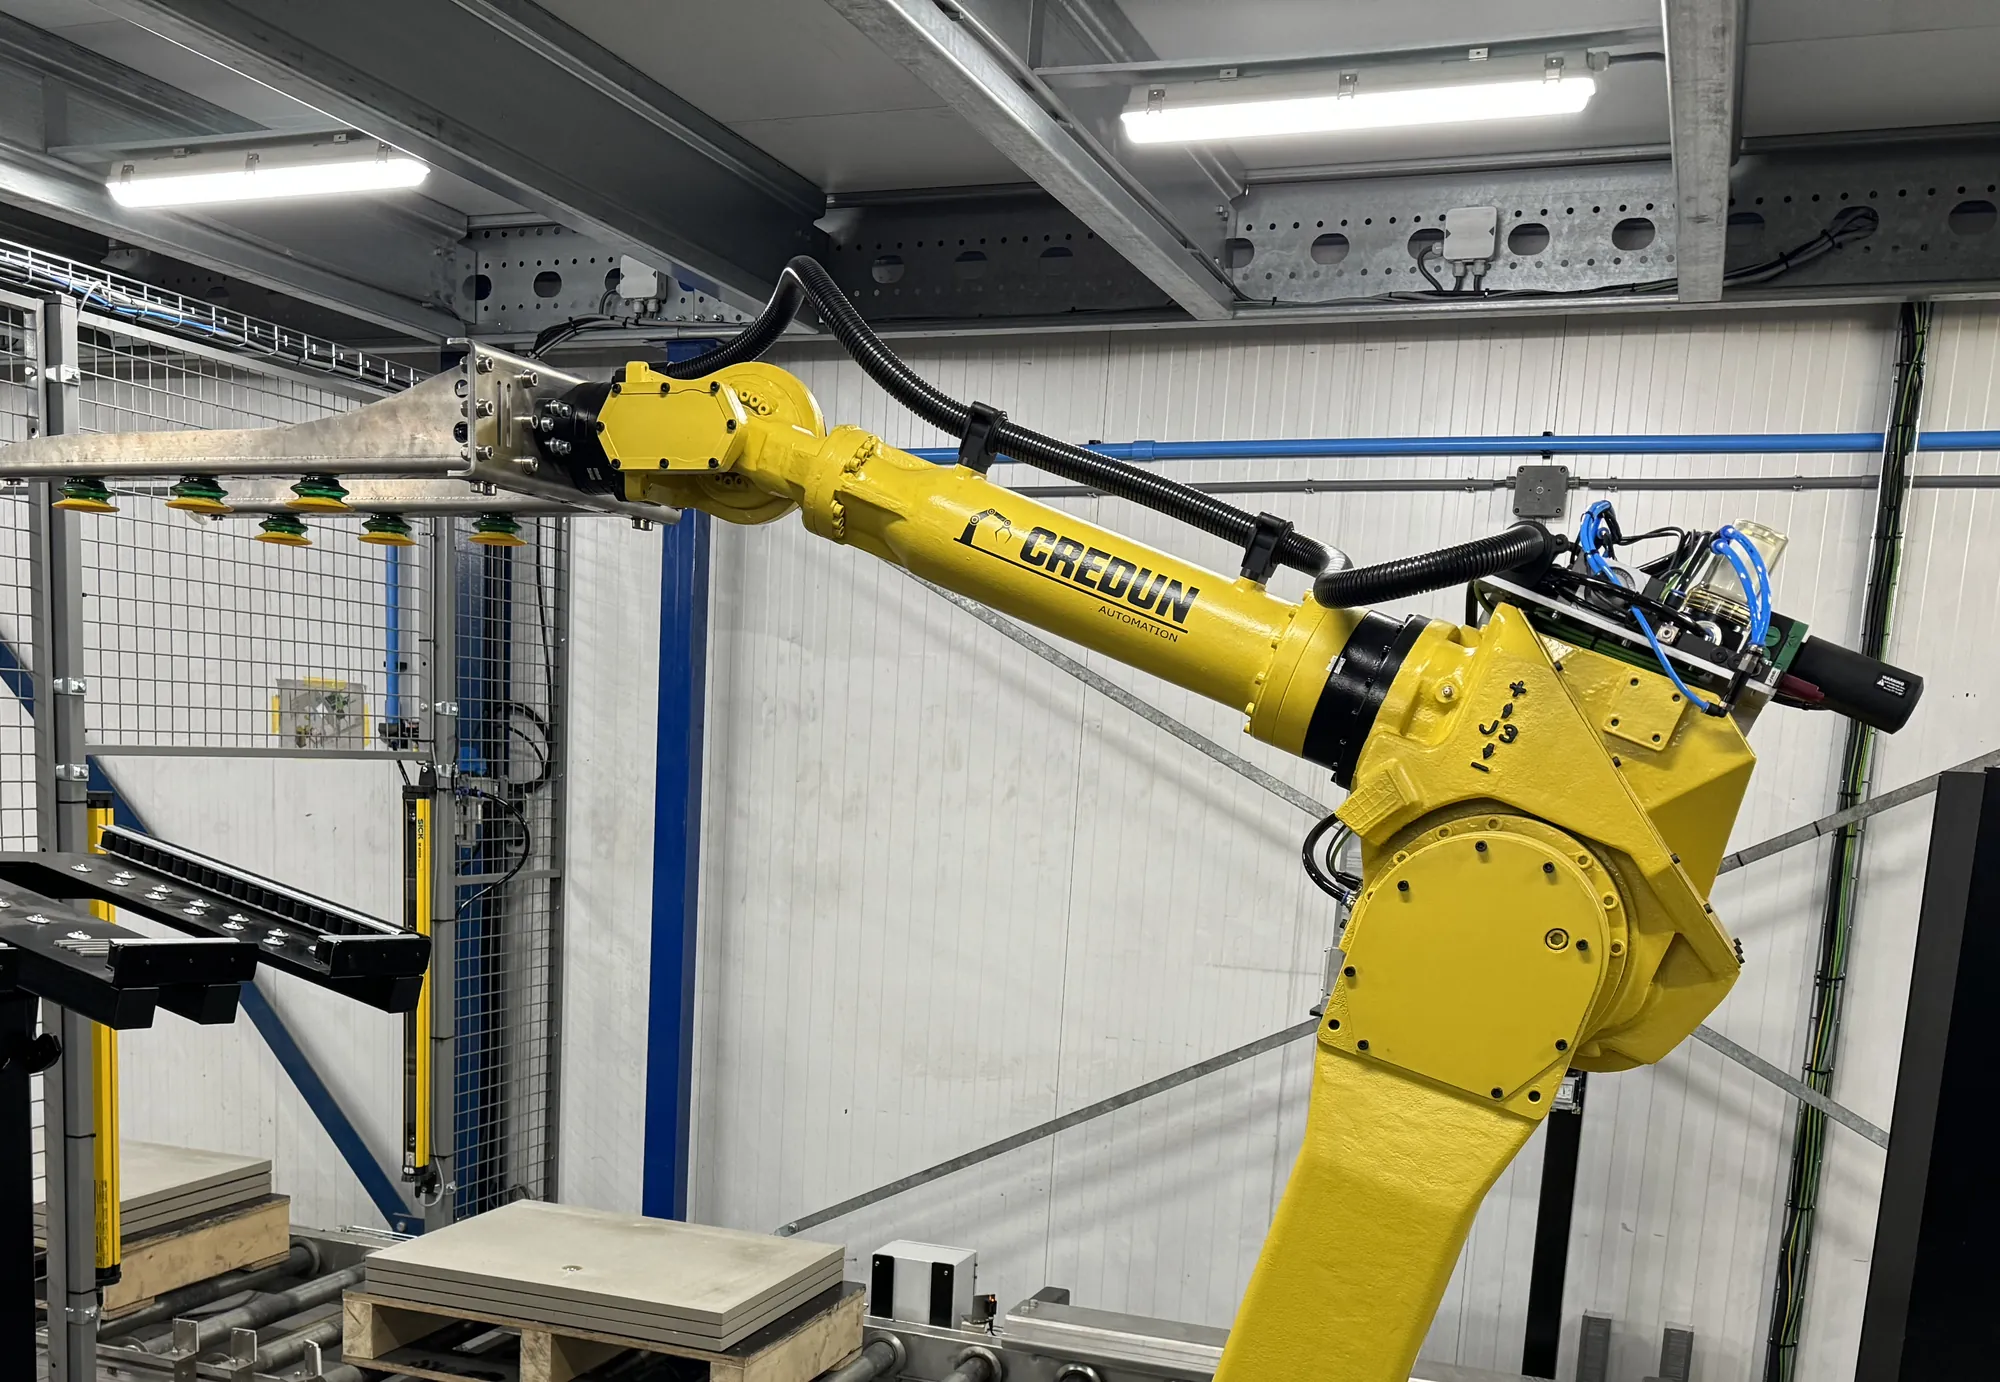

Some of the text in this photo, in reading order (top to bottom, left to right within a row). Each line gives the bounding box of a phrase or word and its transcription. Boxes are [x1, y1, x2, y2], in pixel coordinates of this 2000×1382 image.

[1019, 526, 1200, 624] CREDUN
[1098, 605, 1179, 643] AUTOMATION
[1478, 720, 1519, 744] J3
